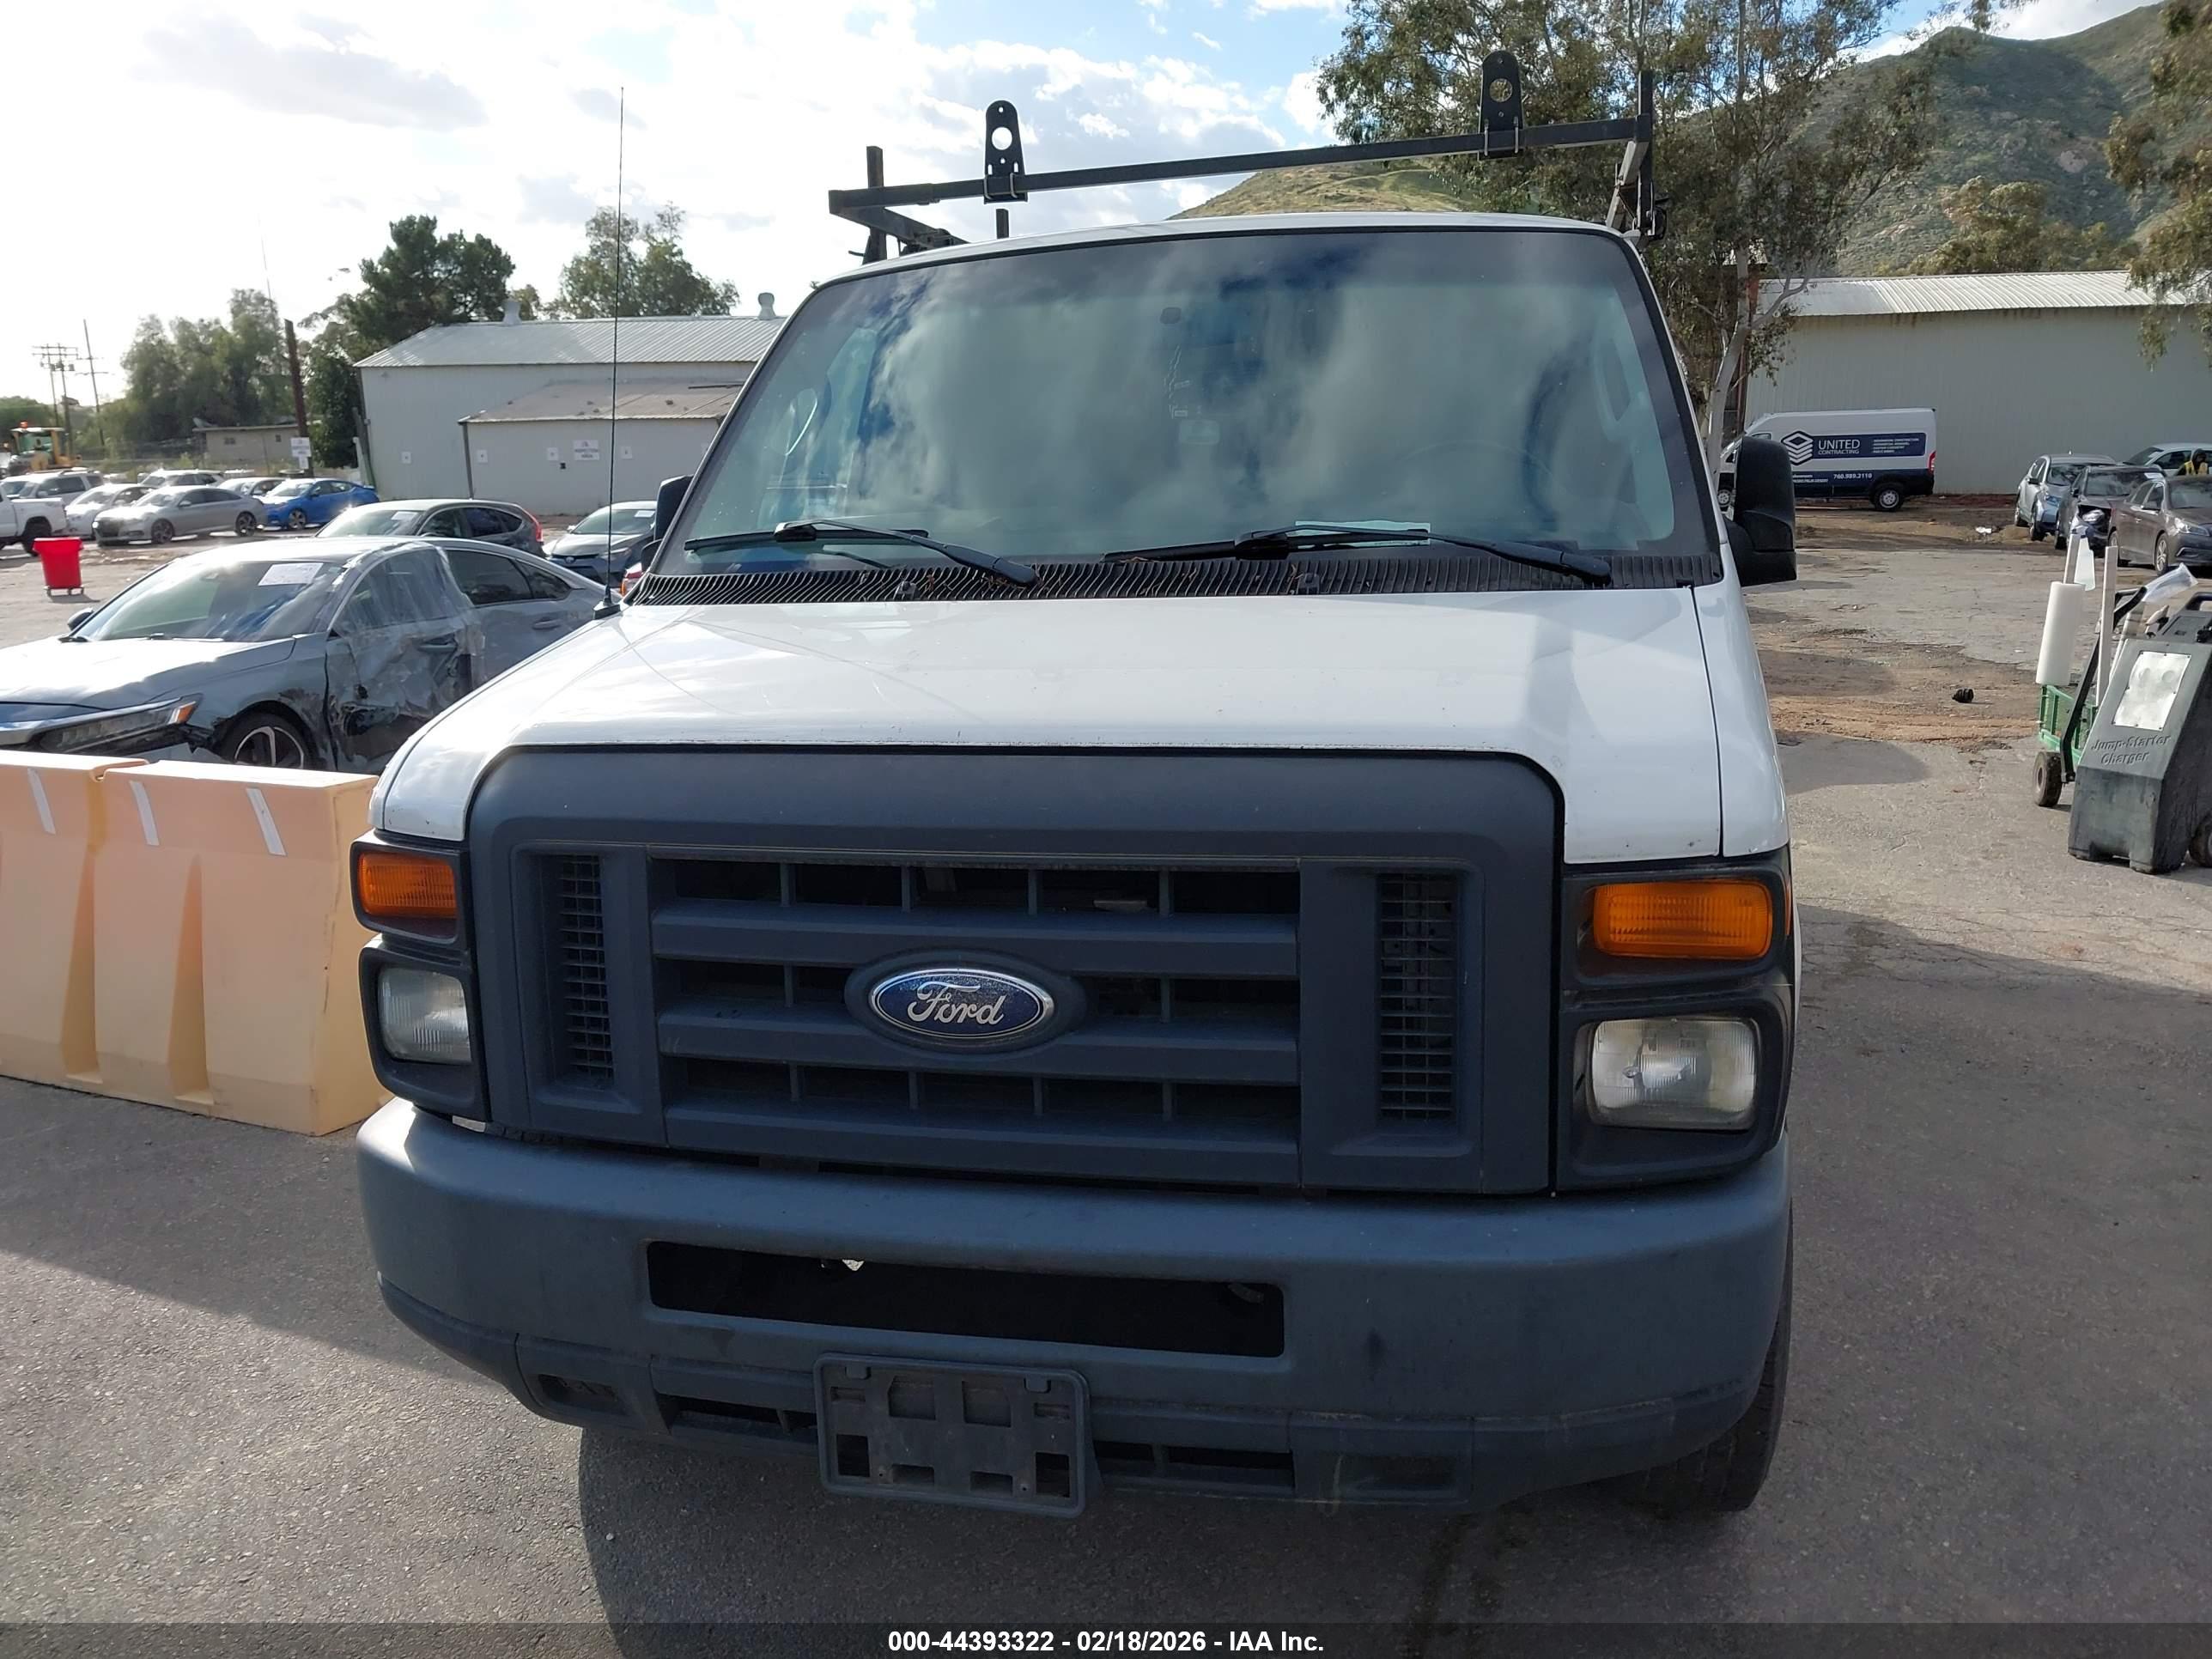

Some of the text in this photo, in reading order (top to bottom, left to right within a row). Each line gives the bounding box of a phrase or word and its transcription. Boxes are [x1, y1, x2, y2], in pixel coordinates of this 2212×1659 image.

[1818, 439, 1861, 450] UNITED
[2100, 750, 2150, 766] Charger
[907, 981, 1006, 1025] Ford
